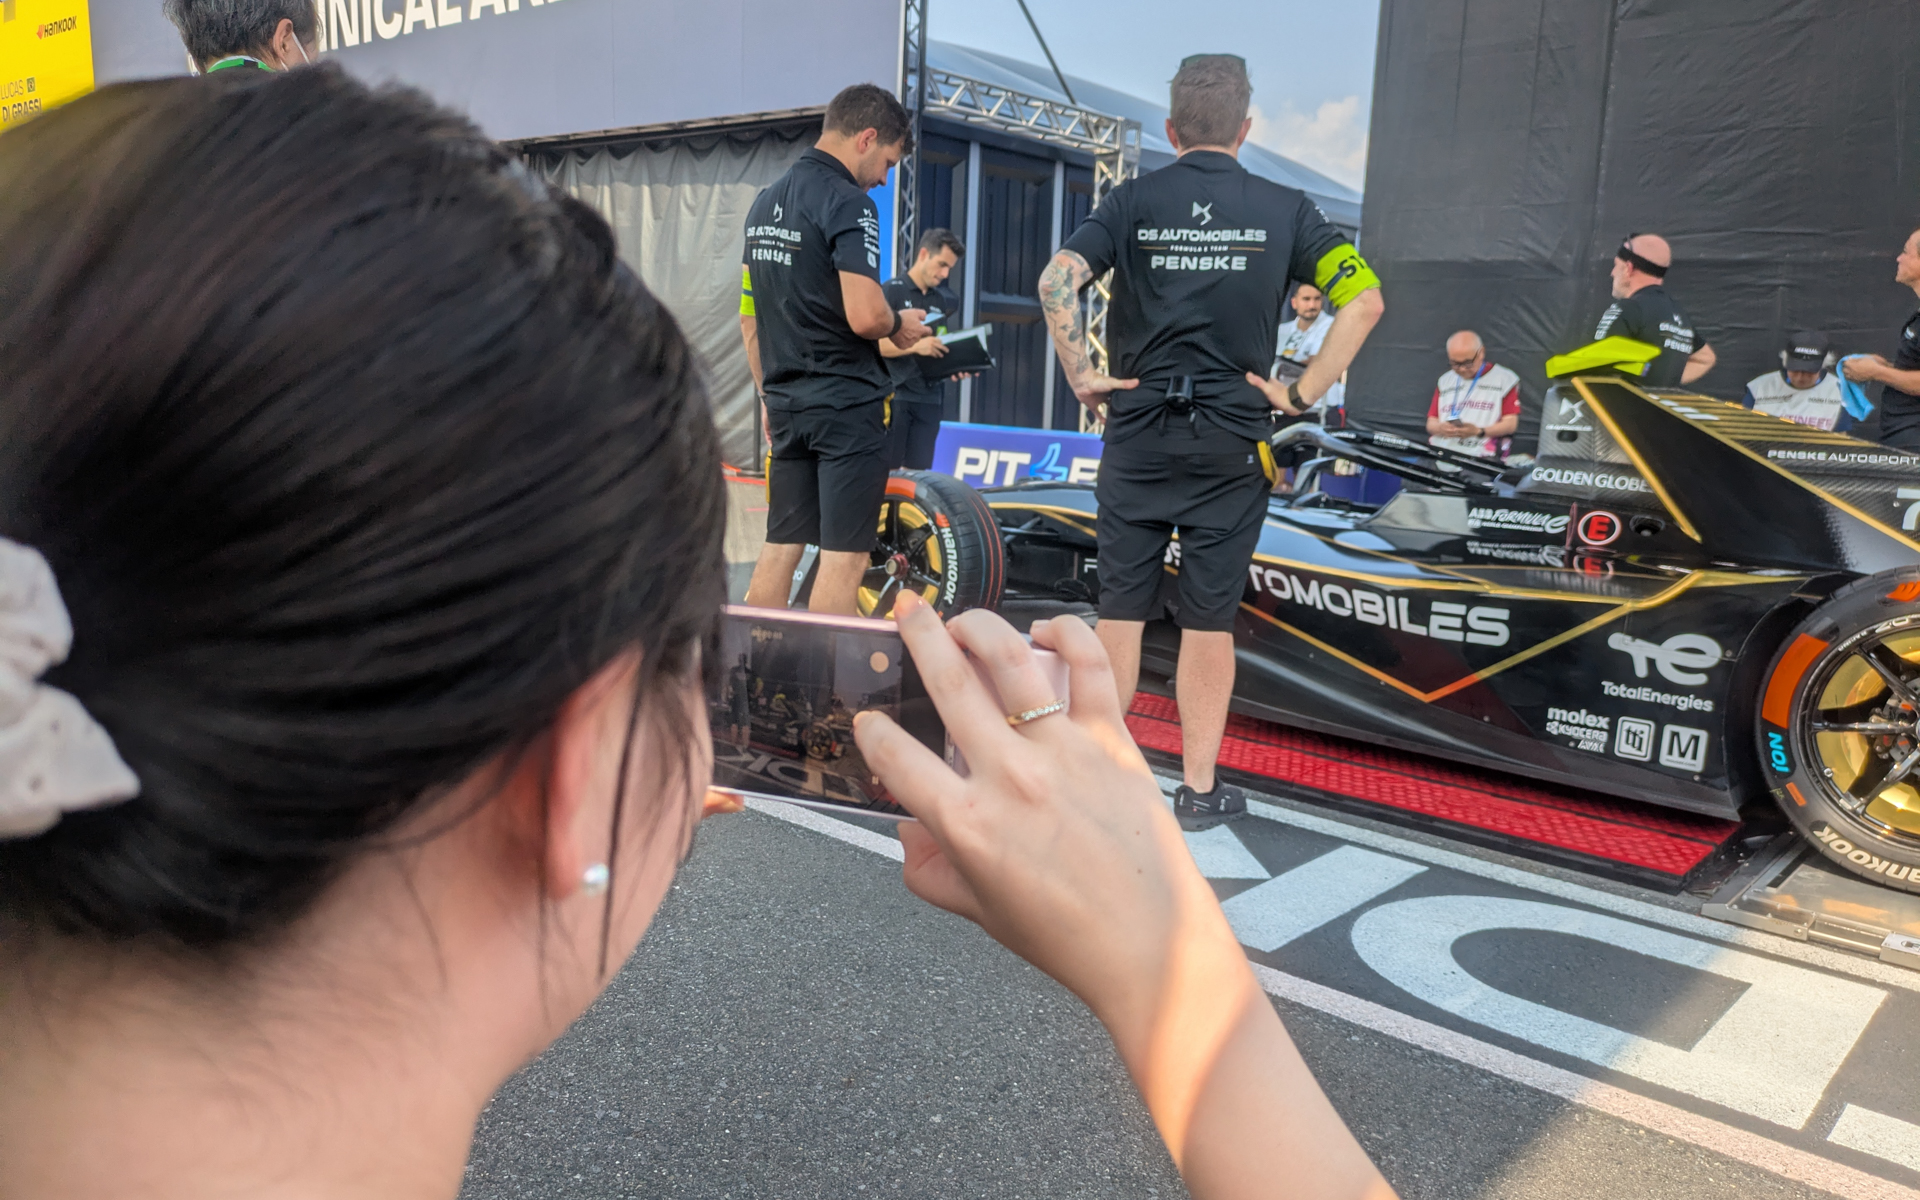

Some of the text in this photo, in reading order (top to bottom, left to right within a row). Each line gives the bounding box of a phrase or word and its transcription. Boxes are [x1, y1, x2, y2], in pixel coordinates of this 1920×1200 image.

[0, 79, 24, 99] LUCAS
[1137, 228, 1267, 242] DS AUTOMOBILES
[1151, 255, 1247, 271] PENSKE
[954, 447, 1031, 486] PIT
[1767, 450, 1920, 465] PENSKE AUTOSPORT
[1532, 467, 1654, 493] GOLDEN GLOBE
[1587, 515, 1611, 540] E
[1249, 563, 1510, 646] TOMOBILES
[1601, 680, 1714, 712] TotalEnergies
[1547, 707, 1610, 730] molex
